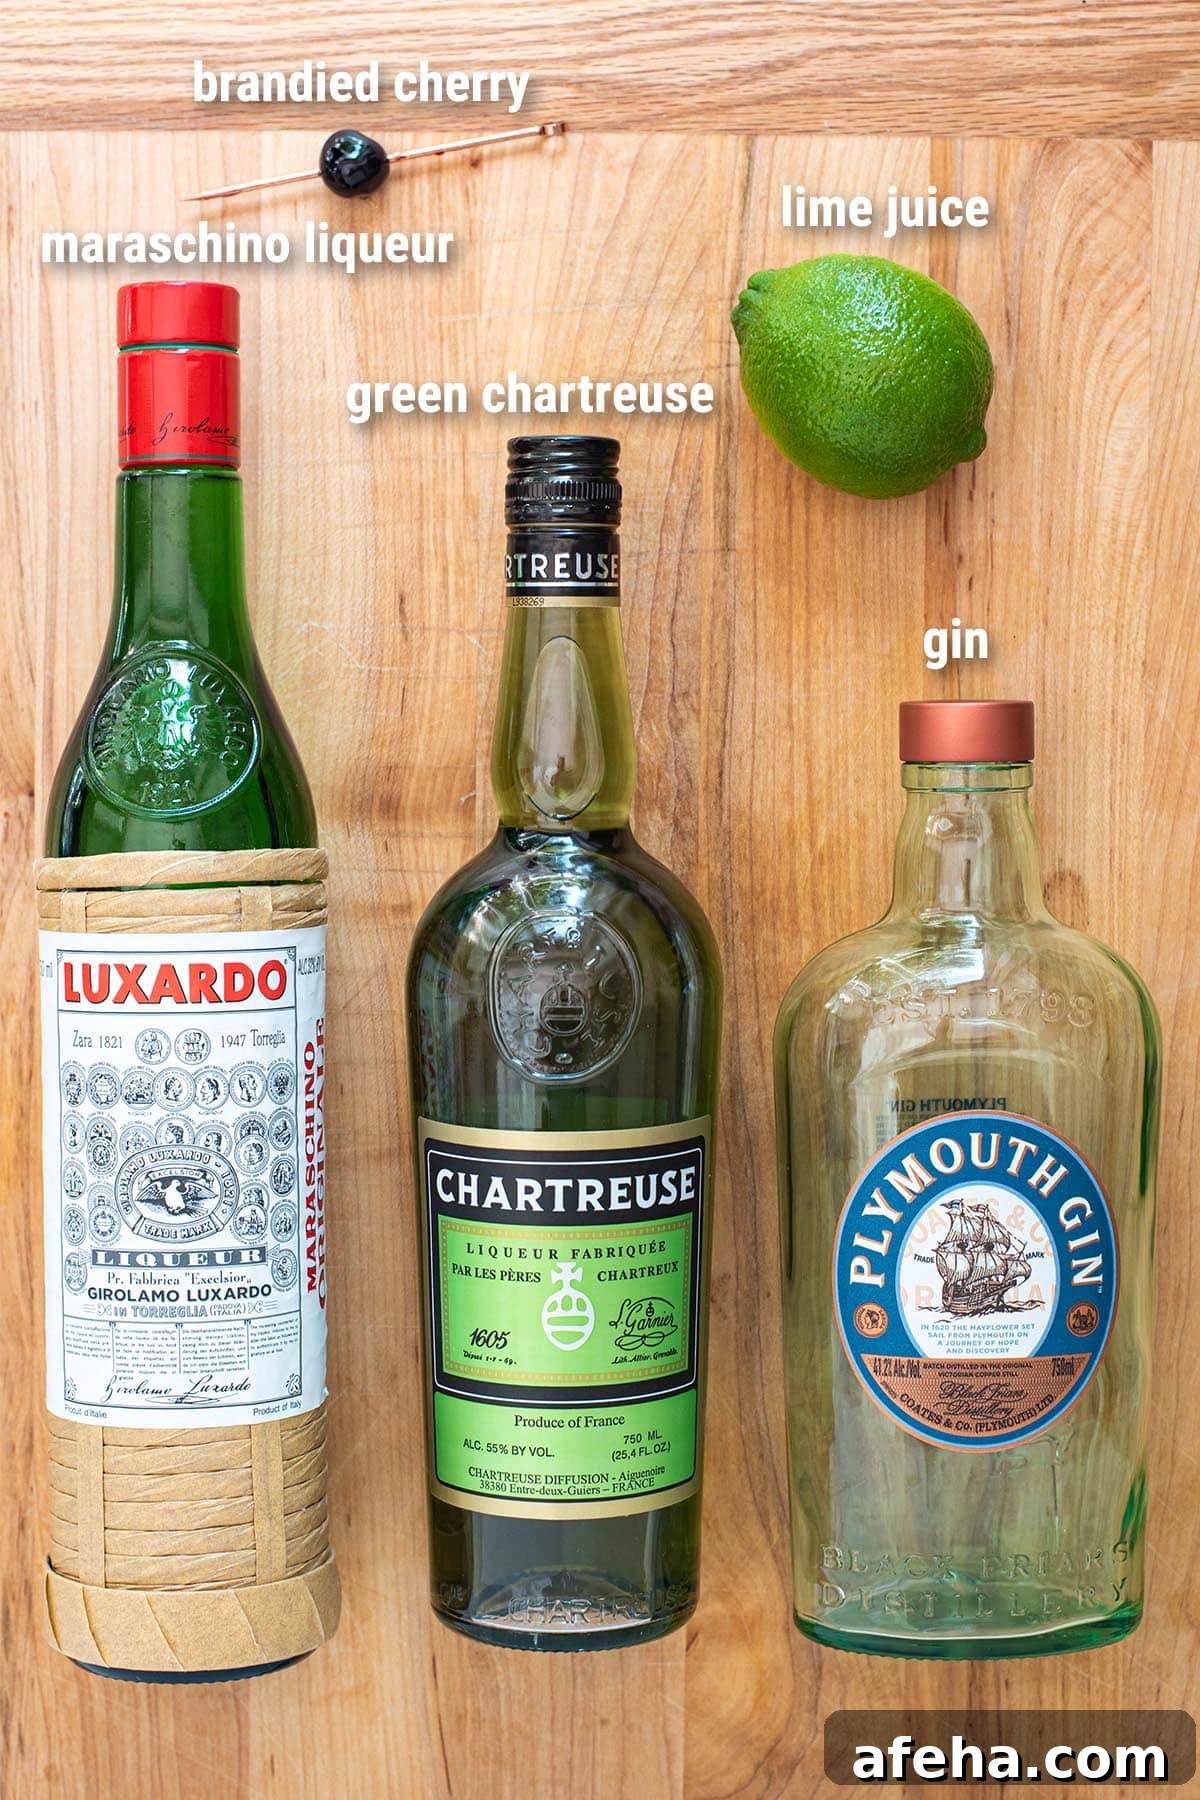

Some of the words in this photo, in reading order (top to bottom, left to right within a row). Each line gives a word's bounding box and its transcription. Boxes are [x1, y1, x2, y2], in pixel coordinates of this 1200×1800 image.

[63, 959, 288, 1005] LUXARDO
[72, 1029, 93, 1048] Zara
[98, 1035, 123, 1049] 1821
[221, 1034, 246, 1048] 1947
[250, 1028, 287, 1050] Torreglia
[148, 1148, 211, 1165] LUXARDO
[304, 1041, 317, 1294] MARASCHINO
[435, 1166, 696, 1213] CHARTREUSE
[849, 1131, 1069, 1289] PLYMOUTH
[1058, 1196, 1104, 1287] GIN
[145, 1223, 178, 1240] TRADE
[180, 1220, 214, 1239] MARK
[95, 1248, 262, 1267] LIQUEUR
[466, 1242, 559, 1261] LIQUEUR
[571, 1239, 667, 1260] FABRIQUÉE
[912, 1253, 936, 1265] TRADE
[1025, 1251, 1046, 1260] MARK
[107, 1271, 124, 1286] Pr.
[129, 1271, 180, 1287] Fabbrica
[451, 1262, 472, 1278] PAR
[474, 1267, 497, 1280] LES
[500, 1266, 542, 1284] PÈRES
[596, 1260, 680, 1283] CHARTREUX
[87, 1286, 180, 1303] GIROLAMO
[187, 1283, 272, 1302] LUXARDO
[131, 1304, 208, 1319] TORREGLIA
[920, 1323, 930, 1331] IN
[952, 1323, 968, 1331] THE
[969, 1323, 1020, 1331] MAYFLOWER
[972, 1331, 1015, 1339] PLYMOUTH
[468, 1327, 512, 1350] 1605
[965, 1347, 1011, 1355] DISCOVERY
[184, 1374, 252, 1395] Luxardo
[252, 1405, 281, 1417] Product
[281, 1402, 288, 1412] of
[899, 1392, 944, 1425] COATES
[943, 1418, 953, 1429] &
[513, 1414, 565, 1429] Produce
[567, 1414, 582, 1428] of
[583, 1414, 626, 1428] France
[463, 1437, 484, 1452] ALC.
[486, 1442, 509, 1456] 55%
[511, 1445, 527, 1457] BY
[528, 1446, 556, 1458] VOL.
[622, 1432, 643, 1446] 750
[647, 1429, 663, 1441] ML
[611, 1449, 637, 1463] (25,4
[467, 1465, 543, 1486] CHARTREUSE
[544, 1472, 610, 1485] DIFFUSION
[618, 1464, 666, 1482] Aiguenoire
[479, 1478, 508, 1493] 38380
[611, 1476, 656, 1494] FRANCE
